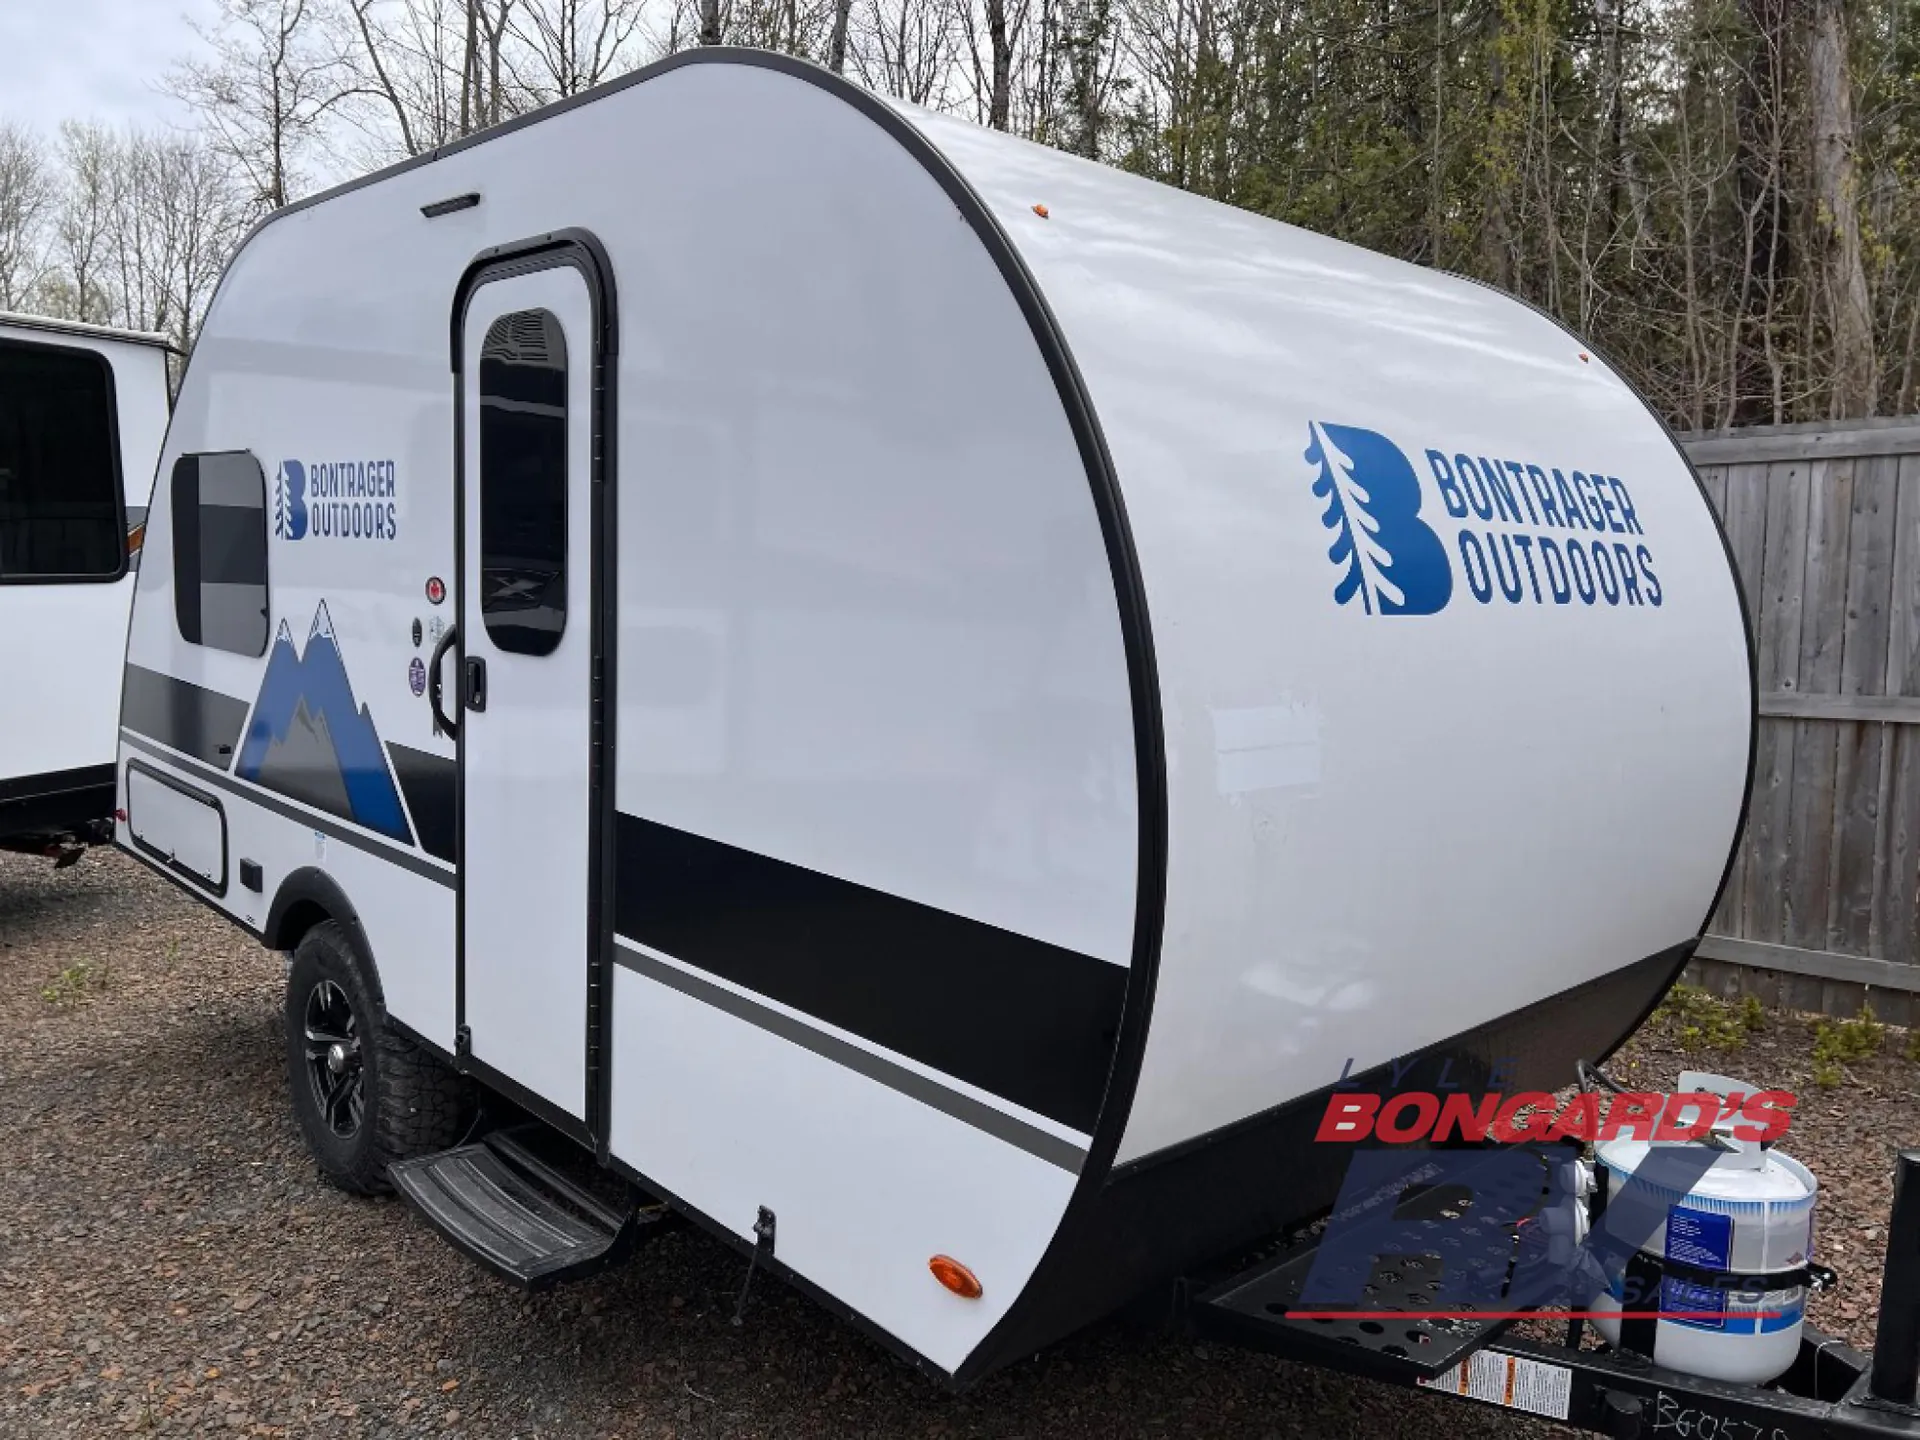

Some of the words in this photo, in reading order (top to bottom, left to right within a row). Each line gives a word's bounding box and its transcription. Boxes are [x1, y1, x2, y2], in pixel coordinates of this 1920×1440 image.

[310, 460, 396, 497] BONTRAGER
[1424, 448, 1645, 535] BONTRAGER
[312, 502, 396, 540] OUTDOORS
[1458, 530, 1662, 606] OUTDOORS
